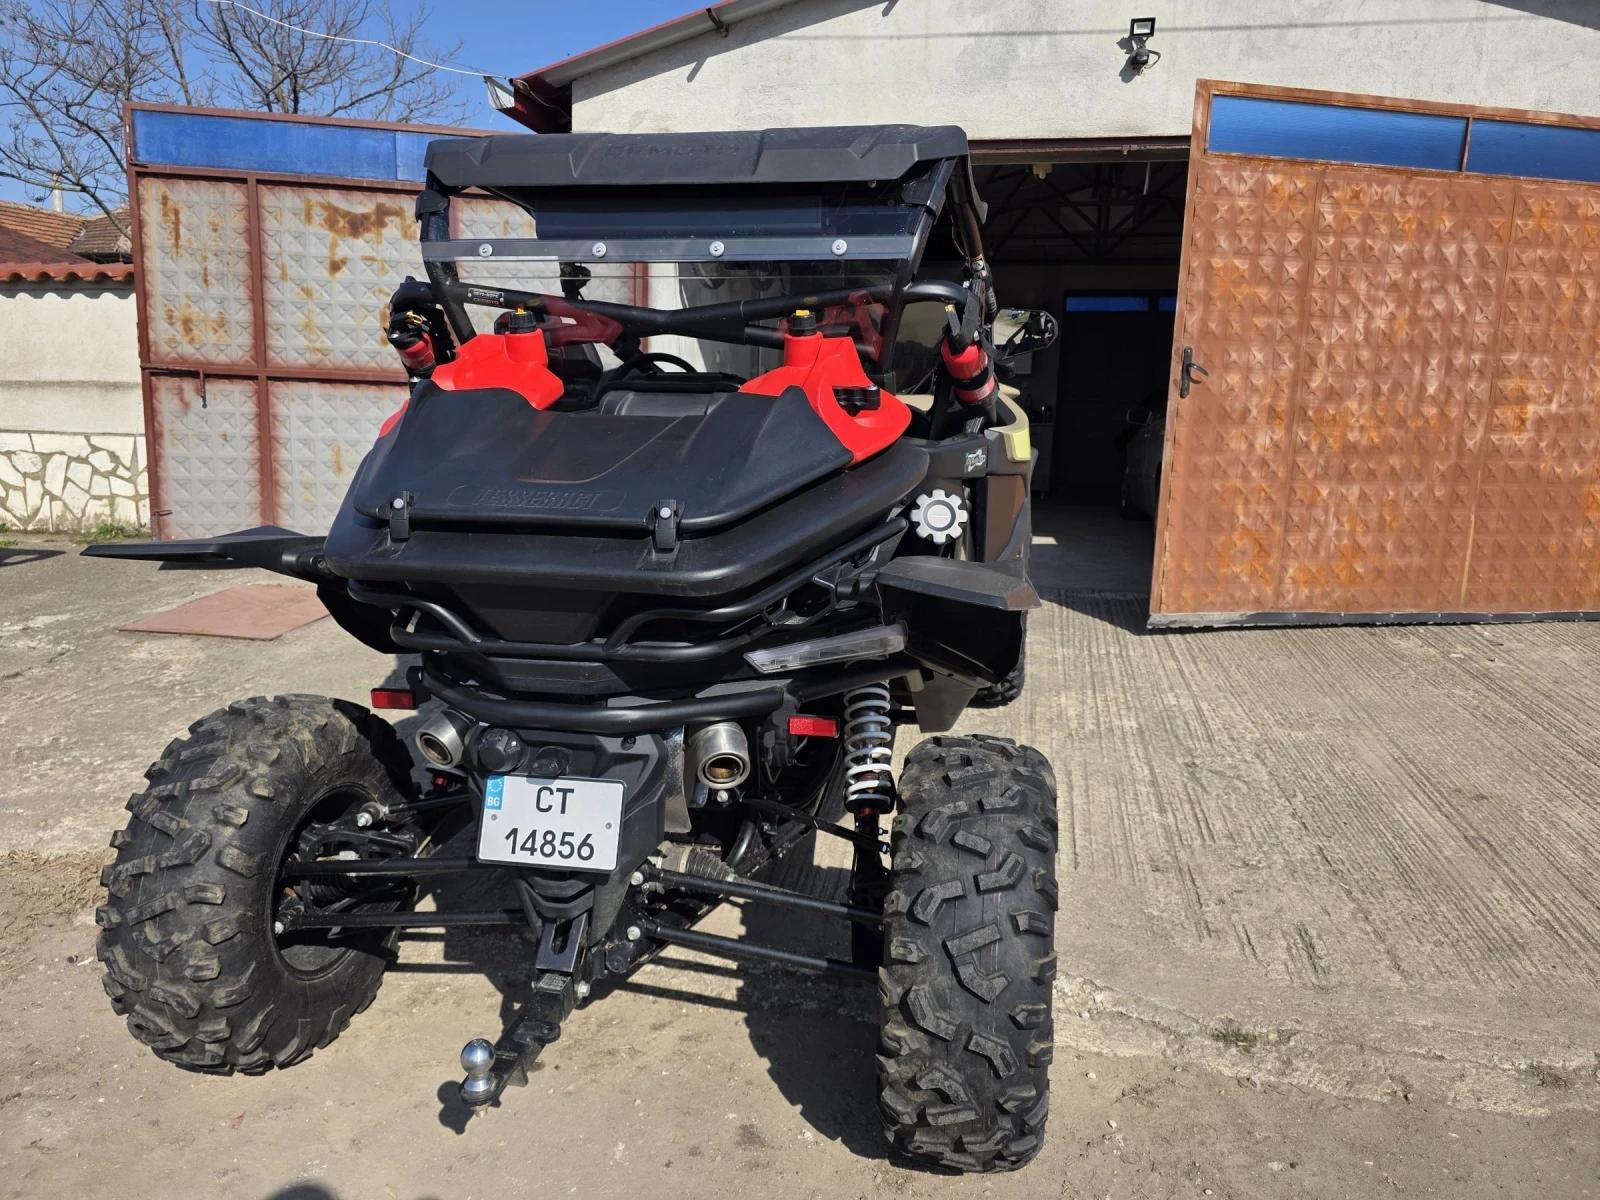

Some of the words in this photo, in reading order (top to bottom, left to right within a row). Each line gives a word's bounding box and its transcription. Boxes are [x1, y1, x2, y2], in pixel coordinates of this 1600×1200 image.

[605, 142, 741, 157] CFMOTO
[474, 488, 602, 510] TESSERACT
[487, 797, 500, 806] BG
[536, 786, 575, 814] CT
[505, 828, 595, 861] 14856
